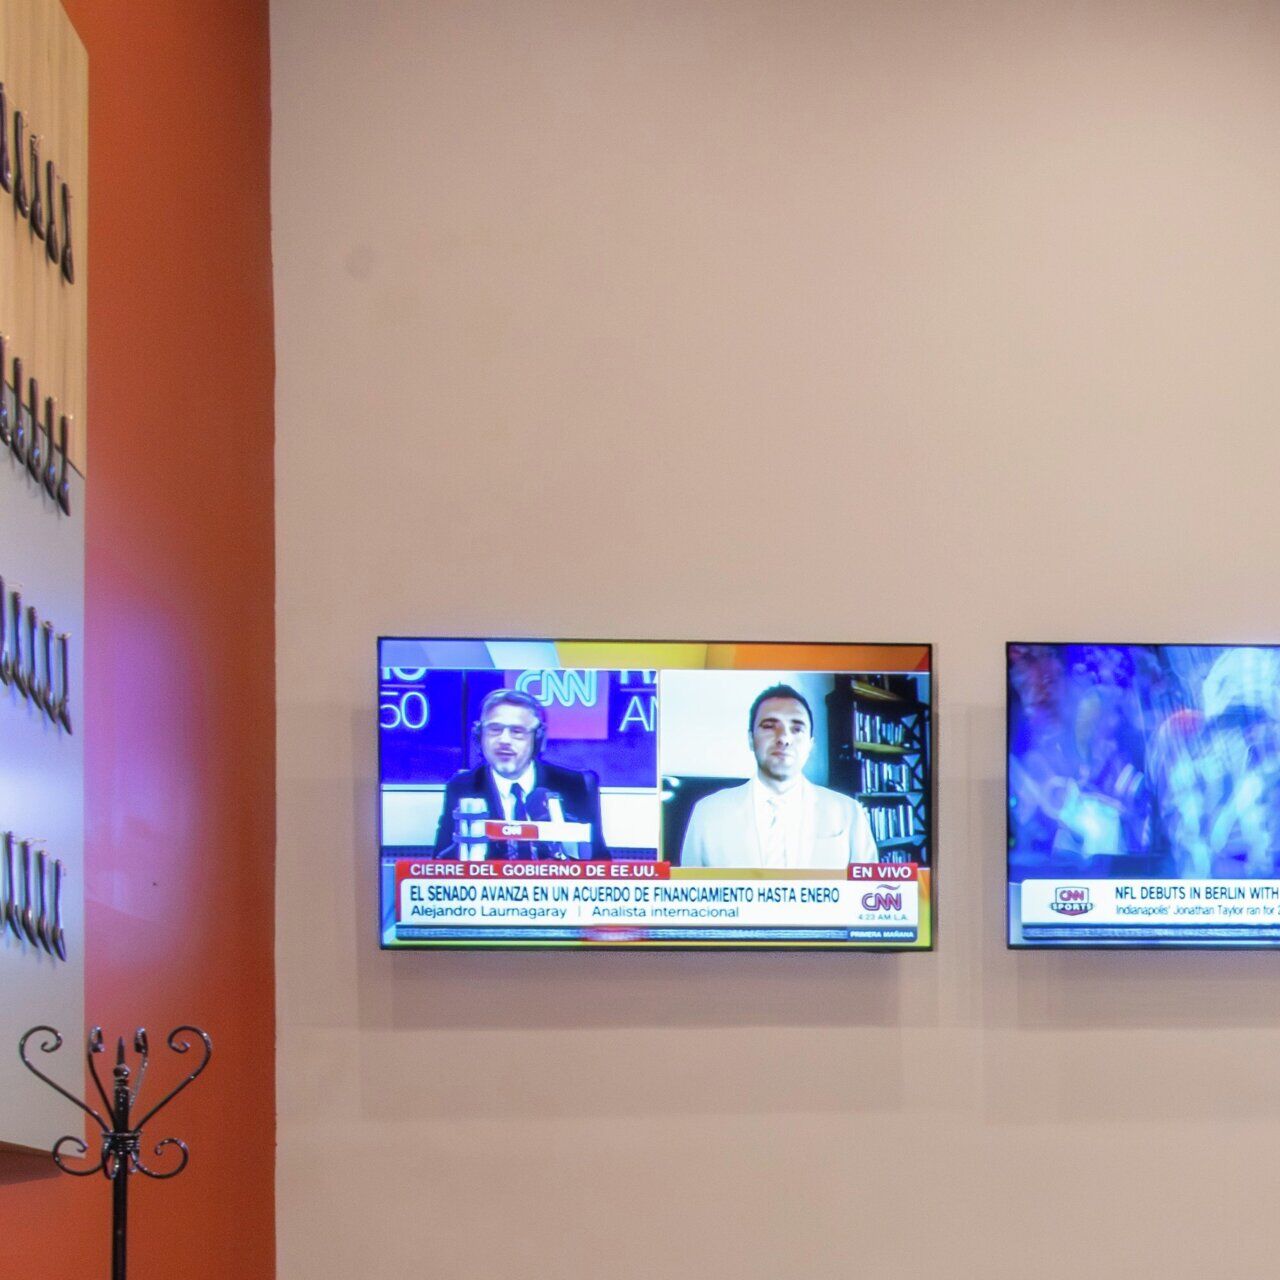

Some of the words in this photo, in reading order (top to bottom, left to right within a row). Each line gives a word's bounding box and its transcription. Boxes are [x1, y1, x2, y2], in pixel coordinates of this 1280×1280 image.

[515, 670, 598, 707] CNN
[410, 864, 464, 876] CIERRE
[470, 864, 498, 876] DEL
[502, 864, 582, 877] GOBIERNO
[586, 865, 606, 877] DE
[610, 865, 659, 877] EE.UU.
[852, 867, 872, 878] EN
[878, 867, 912, 878] VIVO
[410, 886, 424, 901] EL
[427, 886, 477, 902] SENADO
[480, 886, 529, 902] AVANZA
[533, 887, 549, 902] EN
[553, 887, 569, 902] UN
[573, 887, 630, 903] ACUERDO
[635, 887, 649, 903] DE
[653, 887, 753, 903] FINANCIAMIENTO
[757, 887, 796, 903] HASTA
[801, 887, 840, 903] ENERO
[1059, 889, 1085, 901] CNN
[1115, 886, 1137, 900] NFL
[1141, 886, 1185, 900] DEBUTS
[1190, 886, 1200, 900] IN
[1205, 886, 1245, 900] BERLIN
[1249, 887, 1279, 900] WITH
[861, 892, 902, 911] CNN
[1052, 903, 1092, 911] SPORTS
[411, 905, 477, 919] Alejandro
[592, 906, 646, 918] Analista
[651, 906, 739, 918] internacional
[1115, 905, 1171, 917] Indianapolis'
[1173, 905, 1215, 916] Jonathan
[1217, 905, 1244, 917] Taylor
[1247, 907, 1260, 915] ran
[1263, 905, 1274, 915] for
